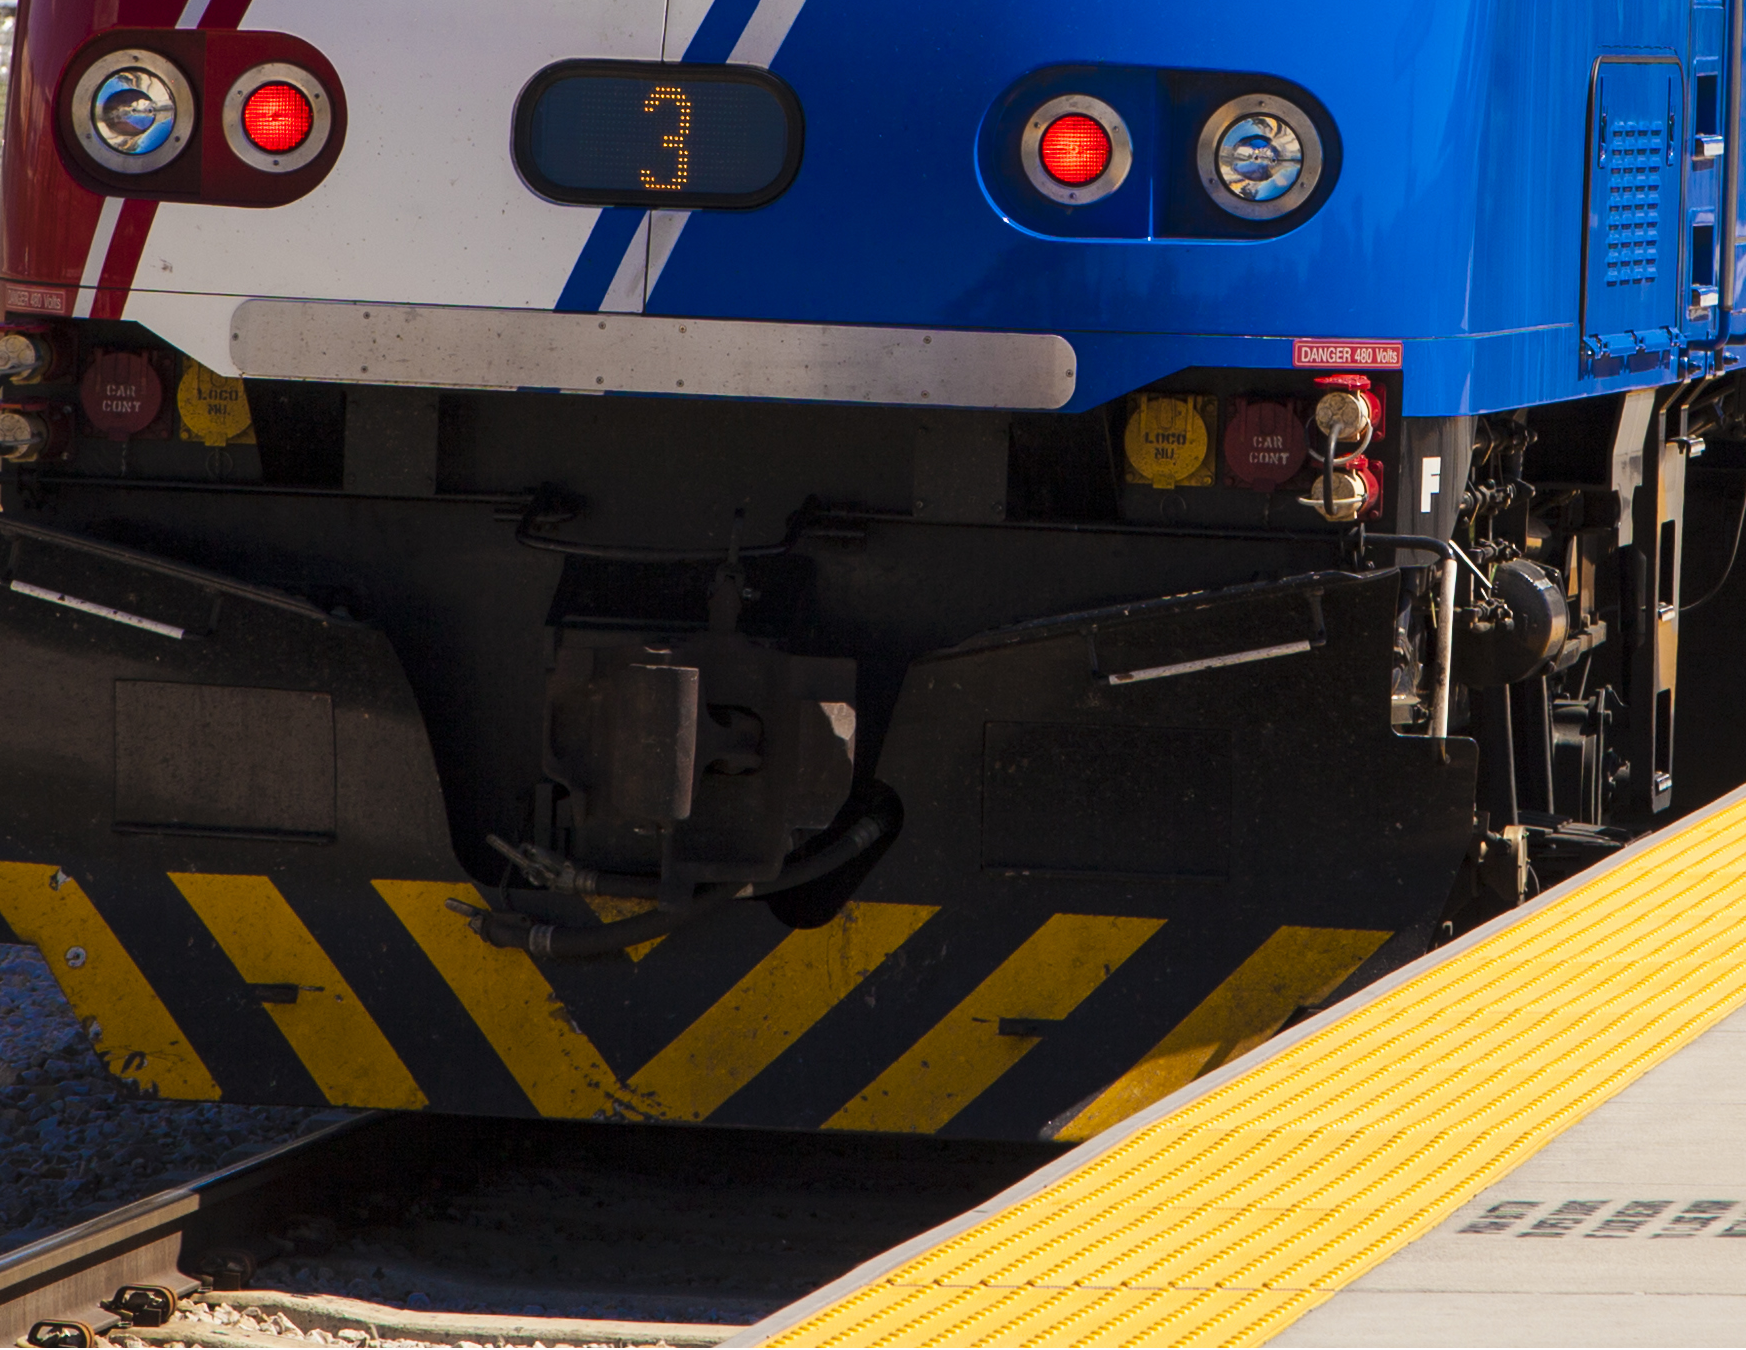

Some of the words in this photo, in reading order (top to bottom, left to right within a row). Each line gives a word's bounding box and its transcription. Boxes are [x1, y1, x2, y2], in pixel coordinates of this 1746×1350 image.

[640, 86, 691, 190] 3
[43, 293, 62, 309] Volts
[1300, 347, 1352, 362] DANGER
[1354, 348, 1373, 363] 480
[1375, 349, 1398, 363] Volts
[106, 384, 136, 398] CAR
[197, 388, 239, 401] LOCO
[102, 400, 142, 413] CONT
[1144, 432, 1187, 446] LOCO
[1253, 435, 1283, 449] CAR
[1249, 451, 1290, 465] CONT
[1420, 456, 1442, 513] F
